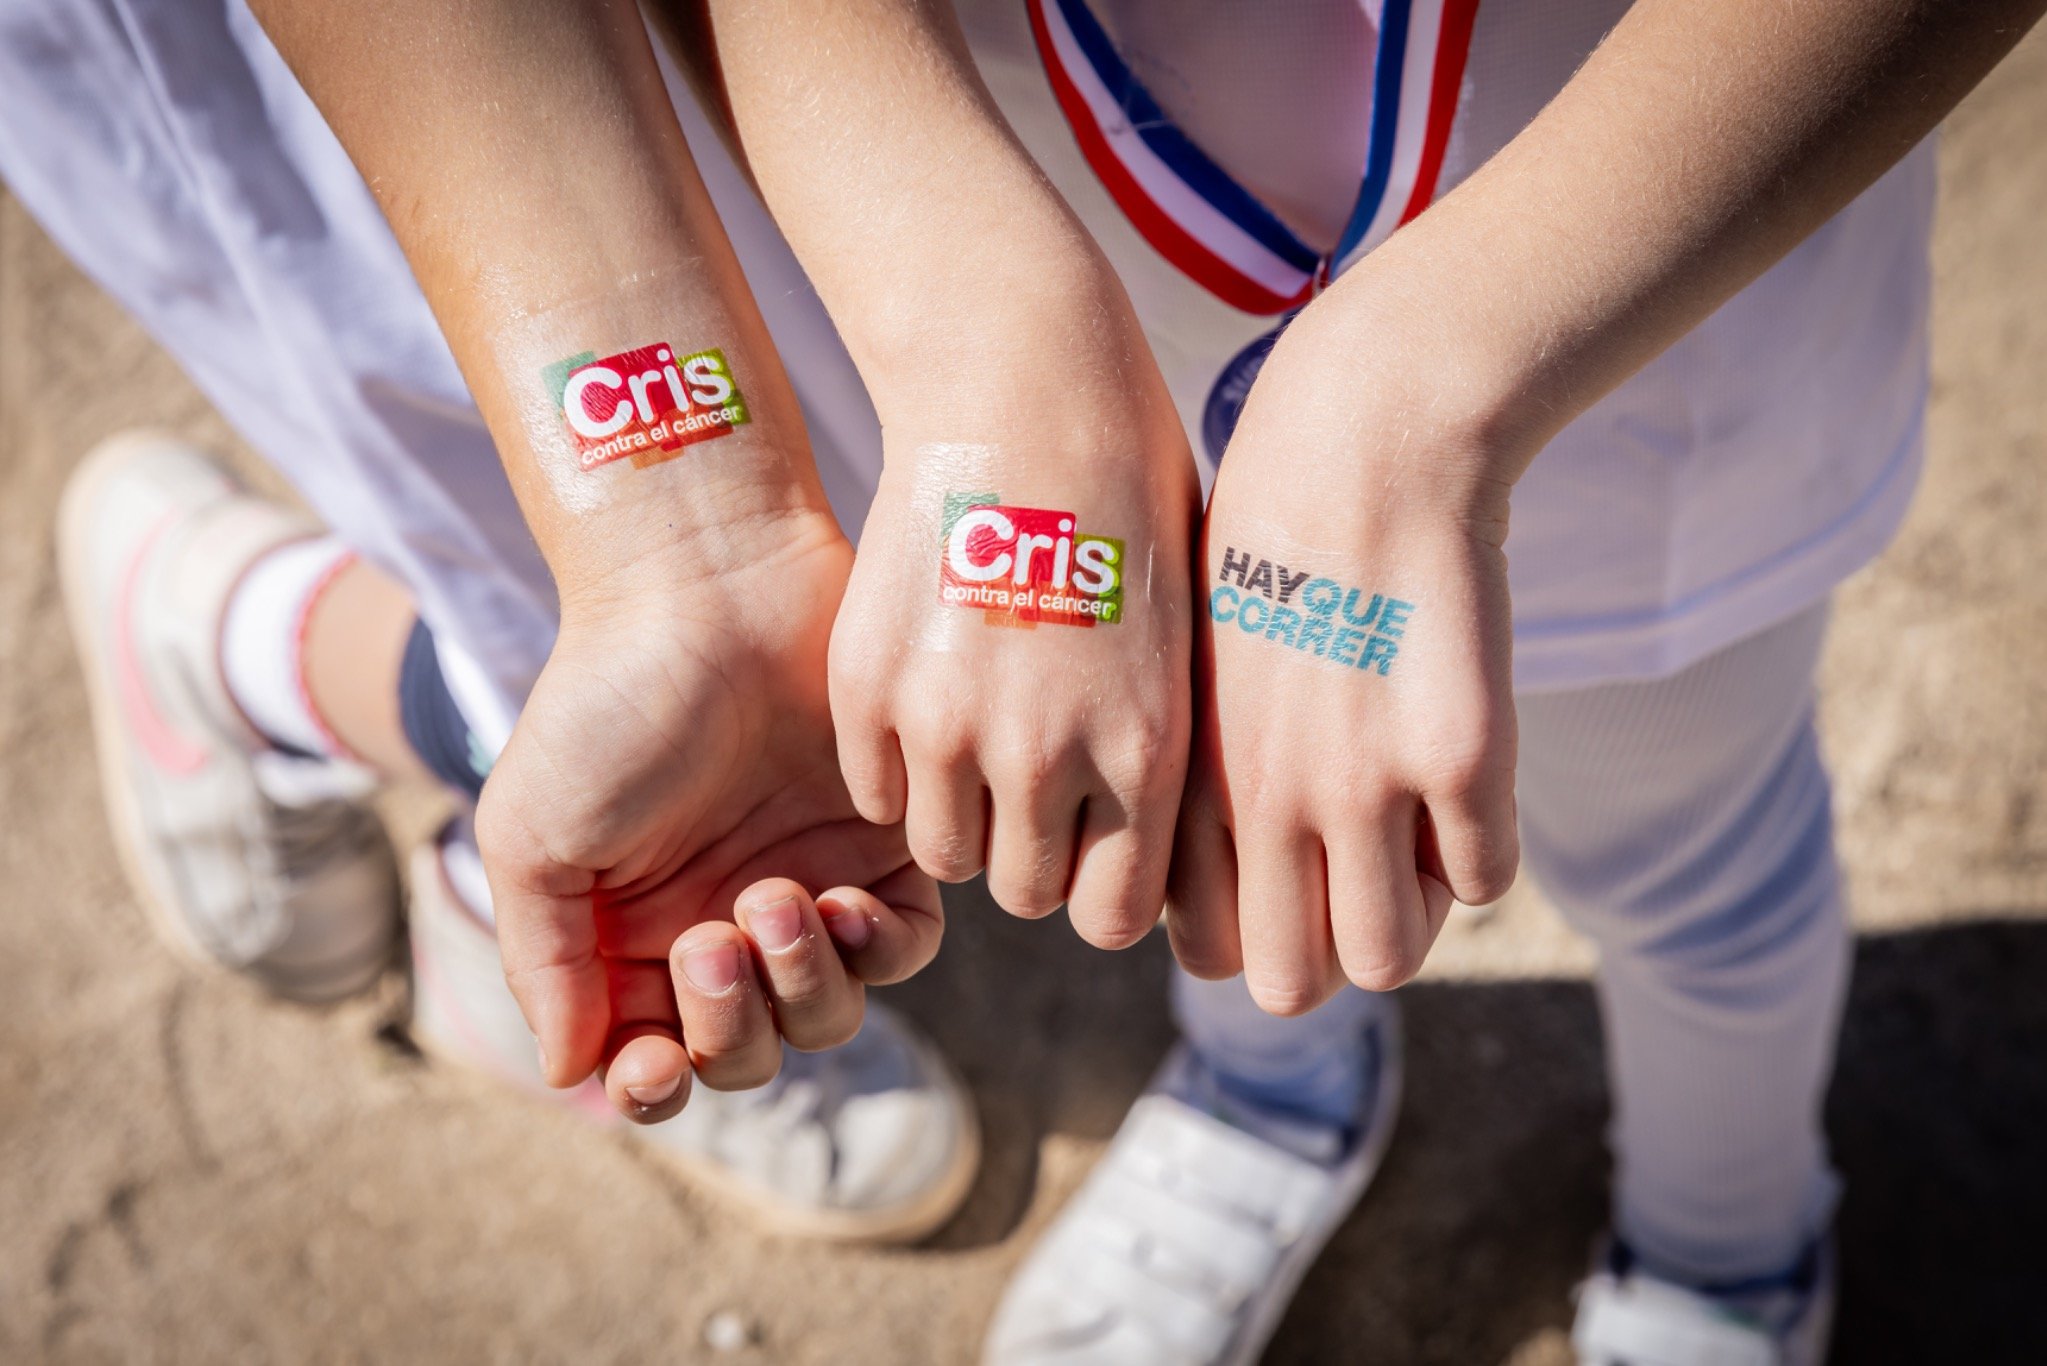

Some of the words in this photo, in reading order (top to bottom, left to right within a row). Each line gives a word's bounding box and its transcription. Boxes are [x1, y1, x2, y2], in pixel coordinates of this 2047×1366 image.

[564, 349, 731, 438] Cris
[582, 432, 647, 465] contra
[650, 424, 669, 441] el
[673, 405, 740, 434] cáncer
[949, 509, 1119, 597] Cris
[942, 586, 1010, 605] contra
[1014, 589, 1034, 606] el
[1038, 592, 1117, 620] cáncer
[1209, 586, 1398, 676] CORRER
